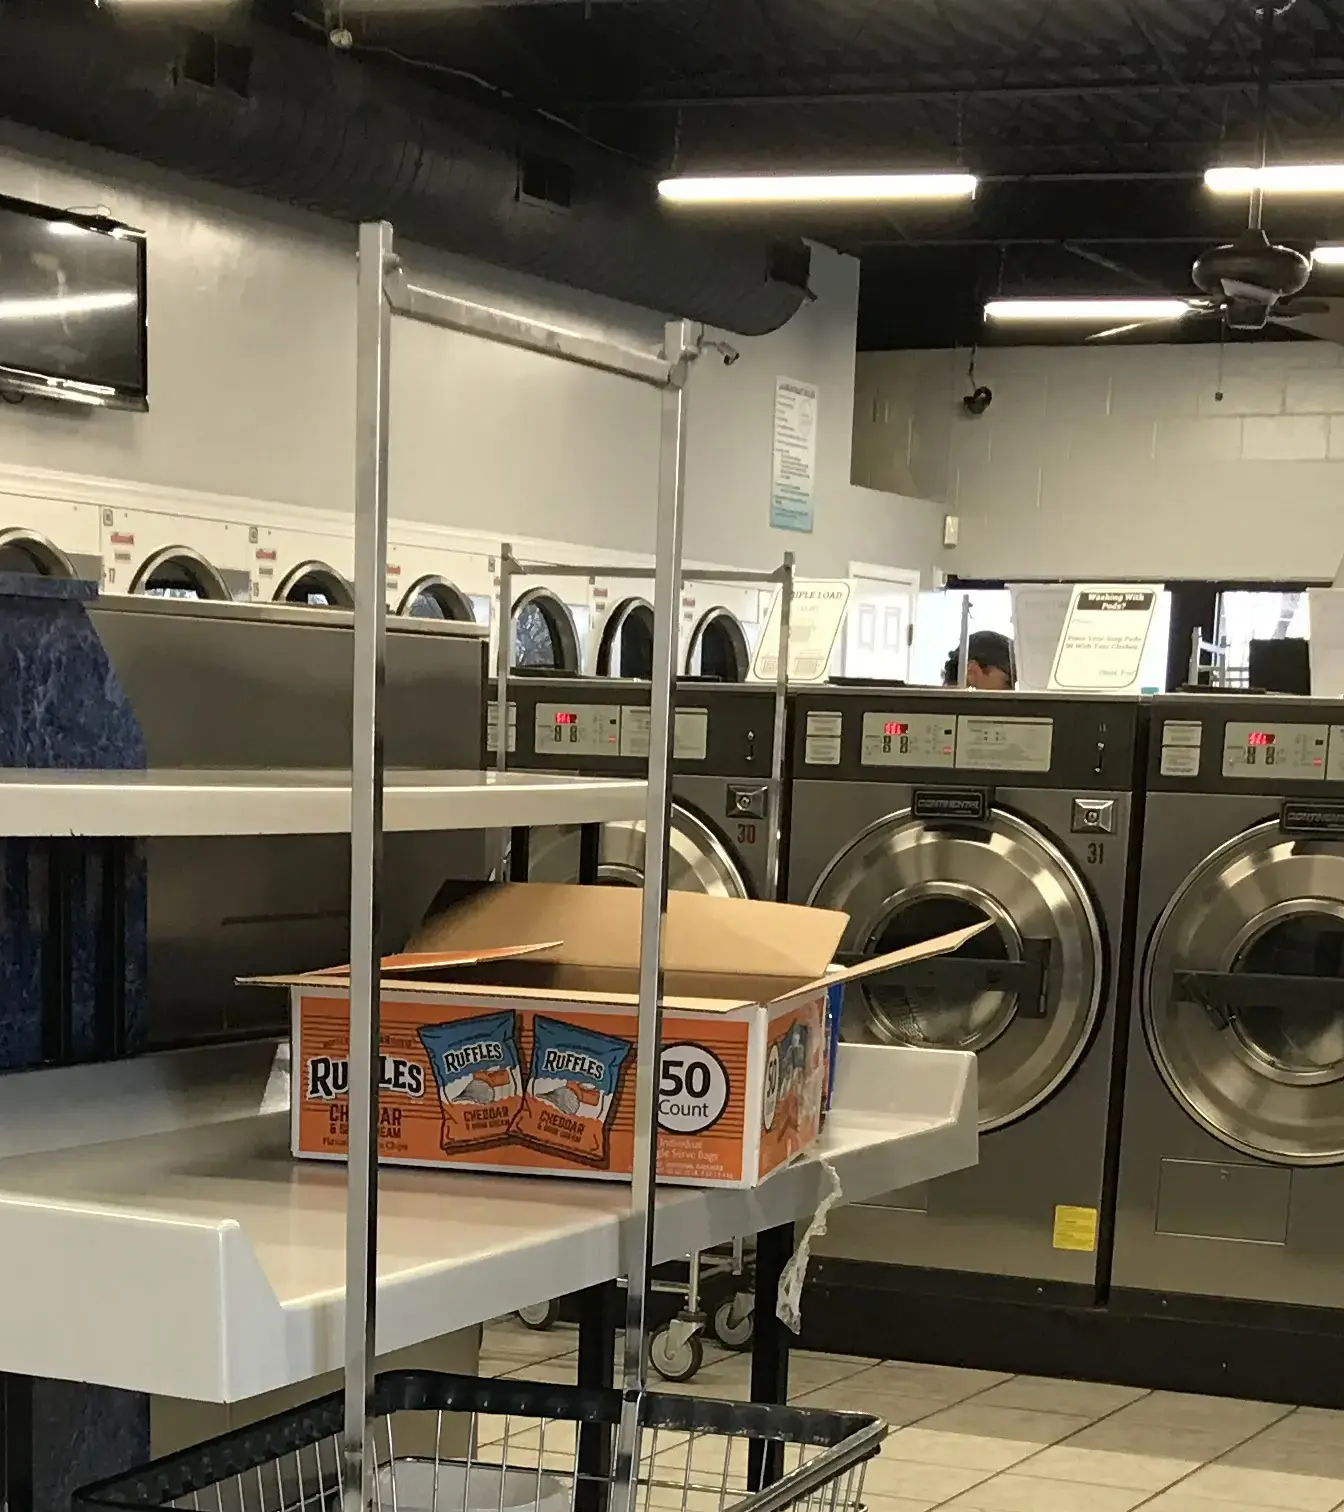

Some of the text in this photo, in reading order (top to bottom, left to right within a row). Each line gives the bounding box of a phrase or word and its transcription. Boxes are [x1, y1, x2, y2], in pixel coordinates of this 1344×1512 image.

[1088, 593, 1144, 602] Washing With
[1101, 602, 1127, 611] Pods?
[737, 822, 756, 844] 30
[1087, 843, 1104, 864] 31
[444, 1043, 503, 1073] RUFFLES
[544, 1050, 604, 1079] RUFFLES
[309, 1056, 423, 1097] RULES
[659, 1060, 711, 1098] 50
[329, 1103, 402, 1127] CHAR
[463, 1106, 509, 1122] CHEDDAR
[658, 1099, 709, 1118] Count
[380, 1126, 402, 1139] EAM
[539, 1110, 585, 1136] CHEDDAR
